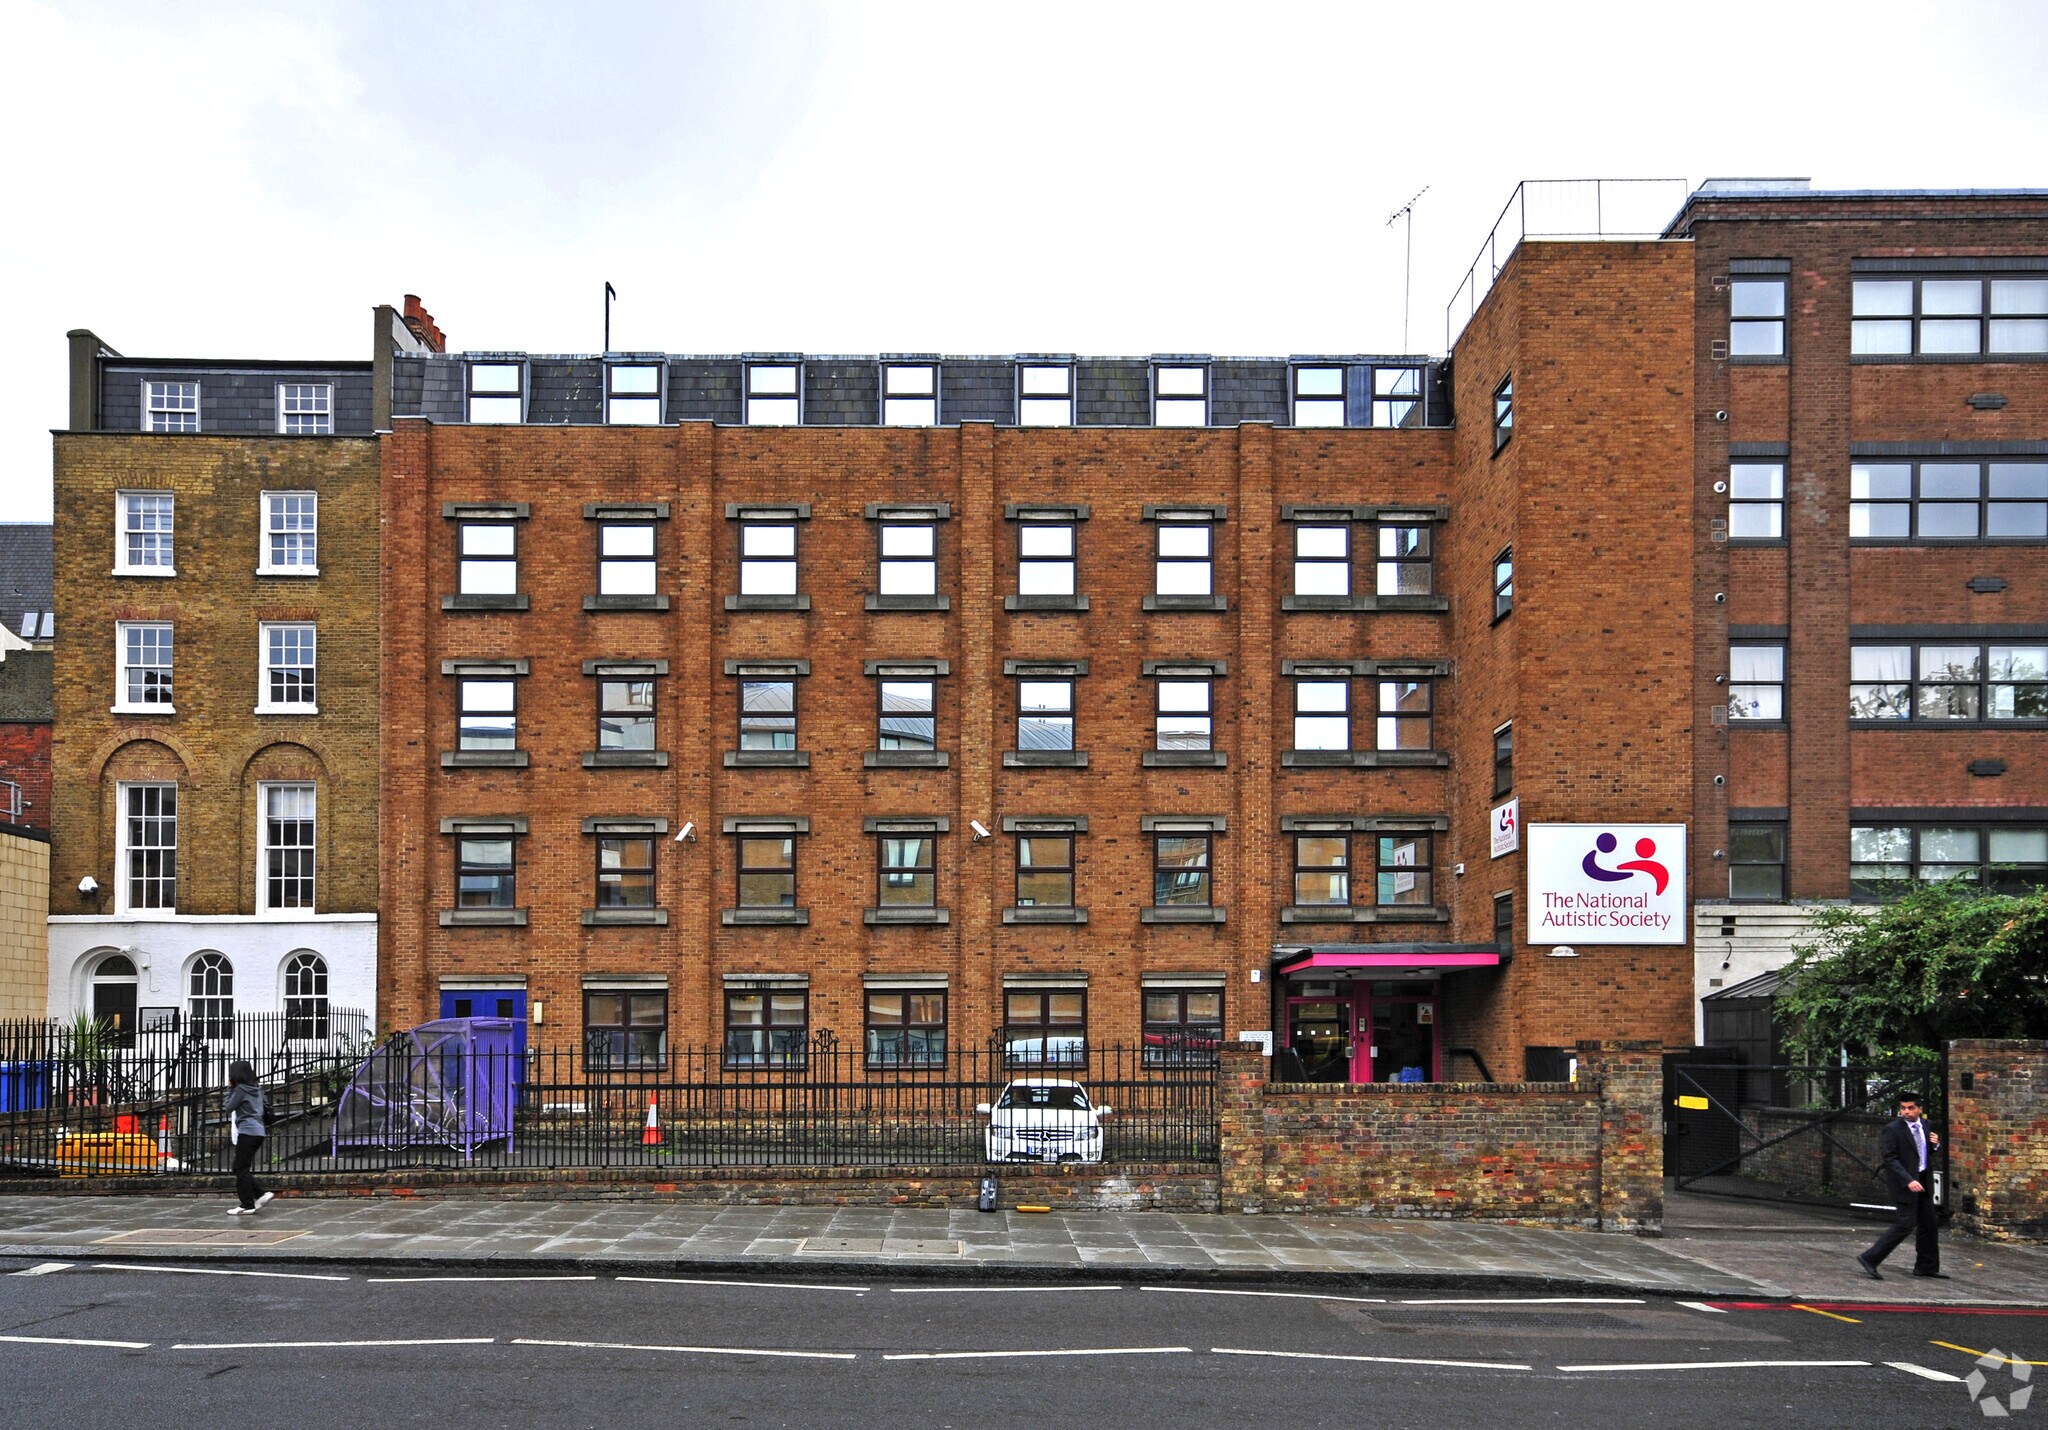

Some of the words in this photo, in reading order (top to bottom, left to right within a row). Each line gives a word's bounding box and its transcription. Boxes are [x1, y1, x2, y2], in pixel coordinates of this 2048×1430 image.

[1542, 892, 1573, 908] The
[1576, 892, 1648, 908] National
[1542, 911, 1607, 926] Autistic
[1609, 911, 1671, 931] Society
